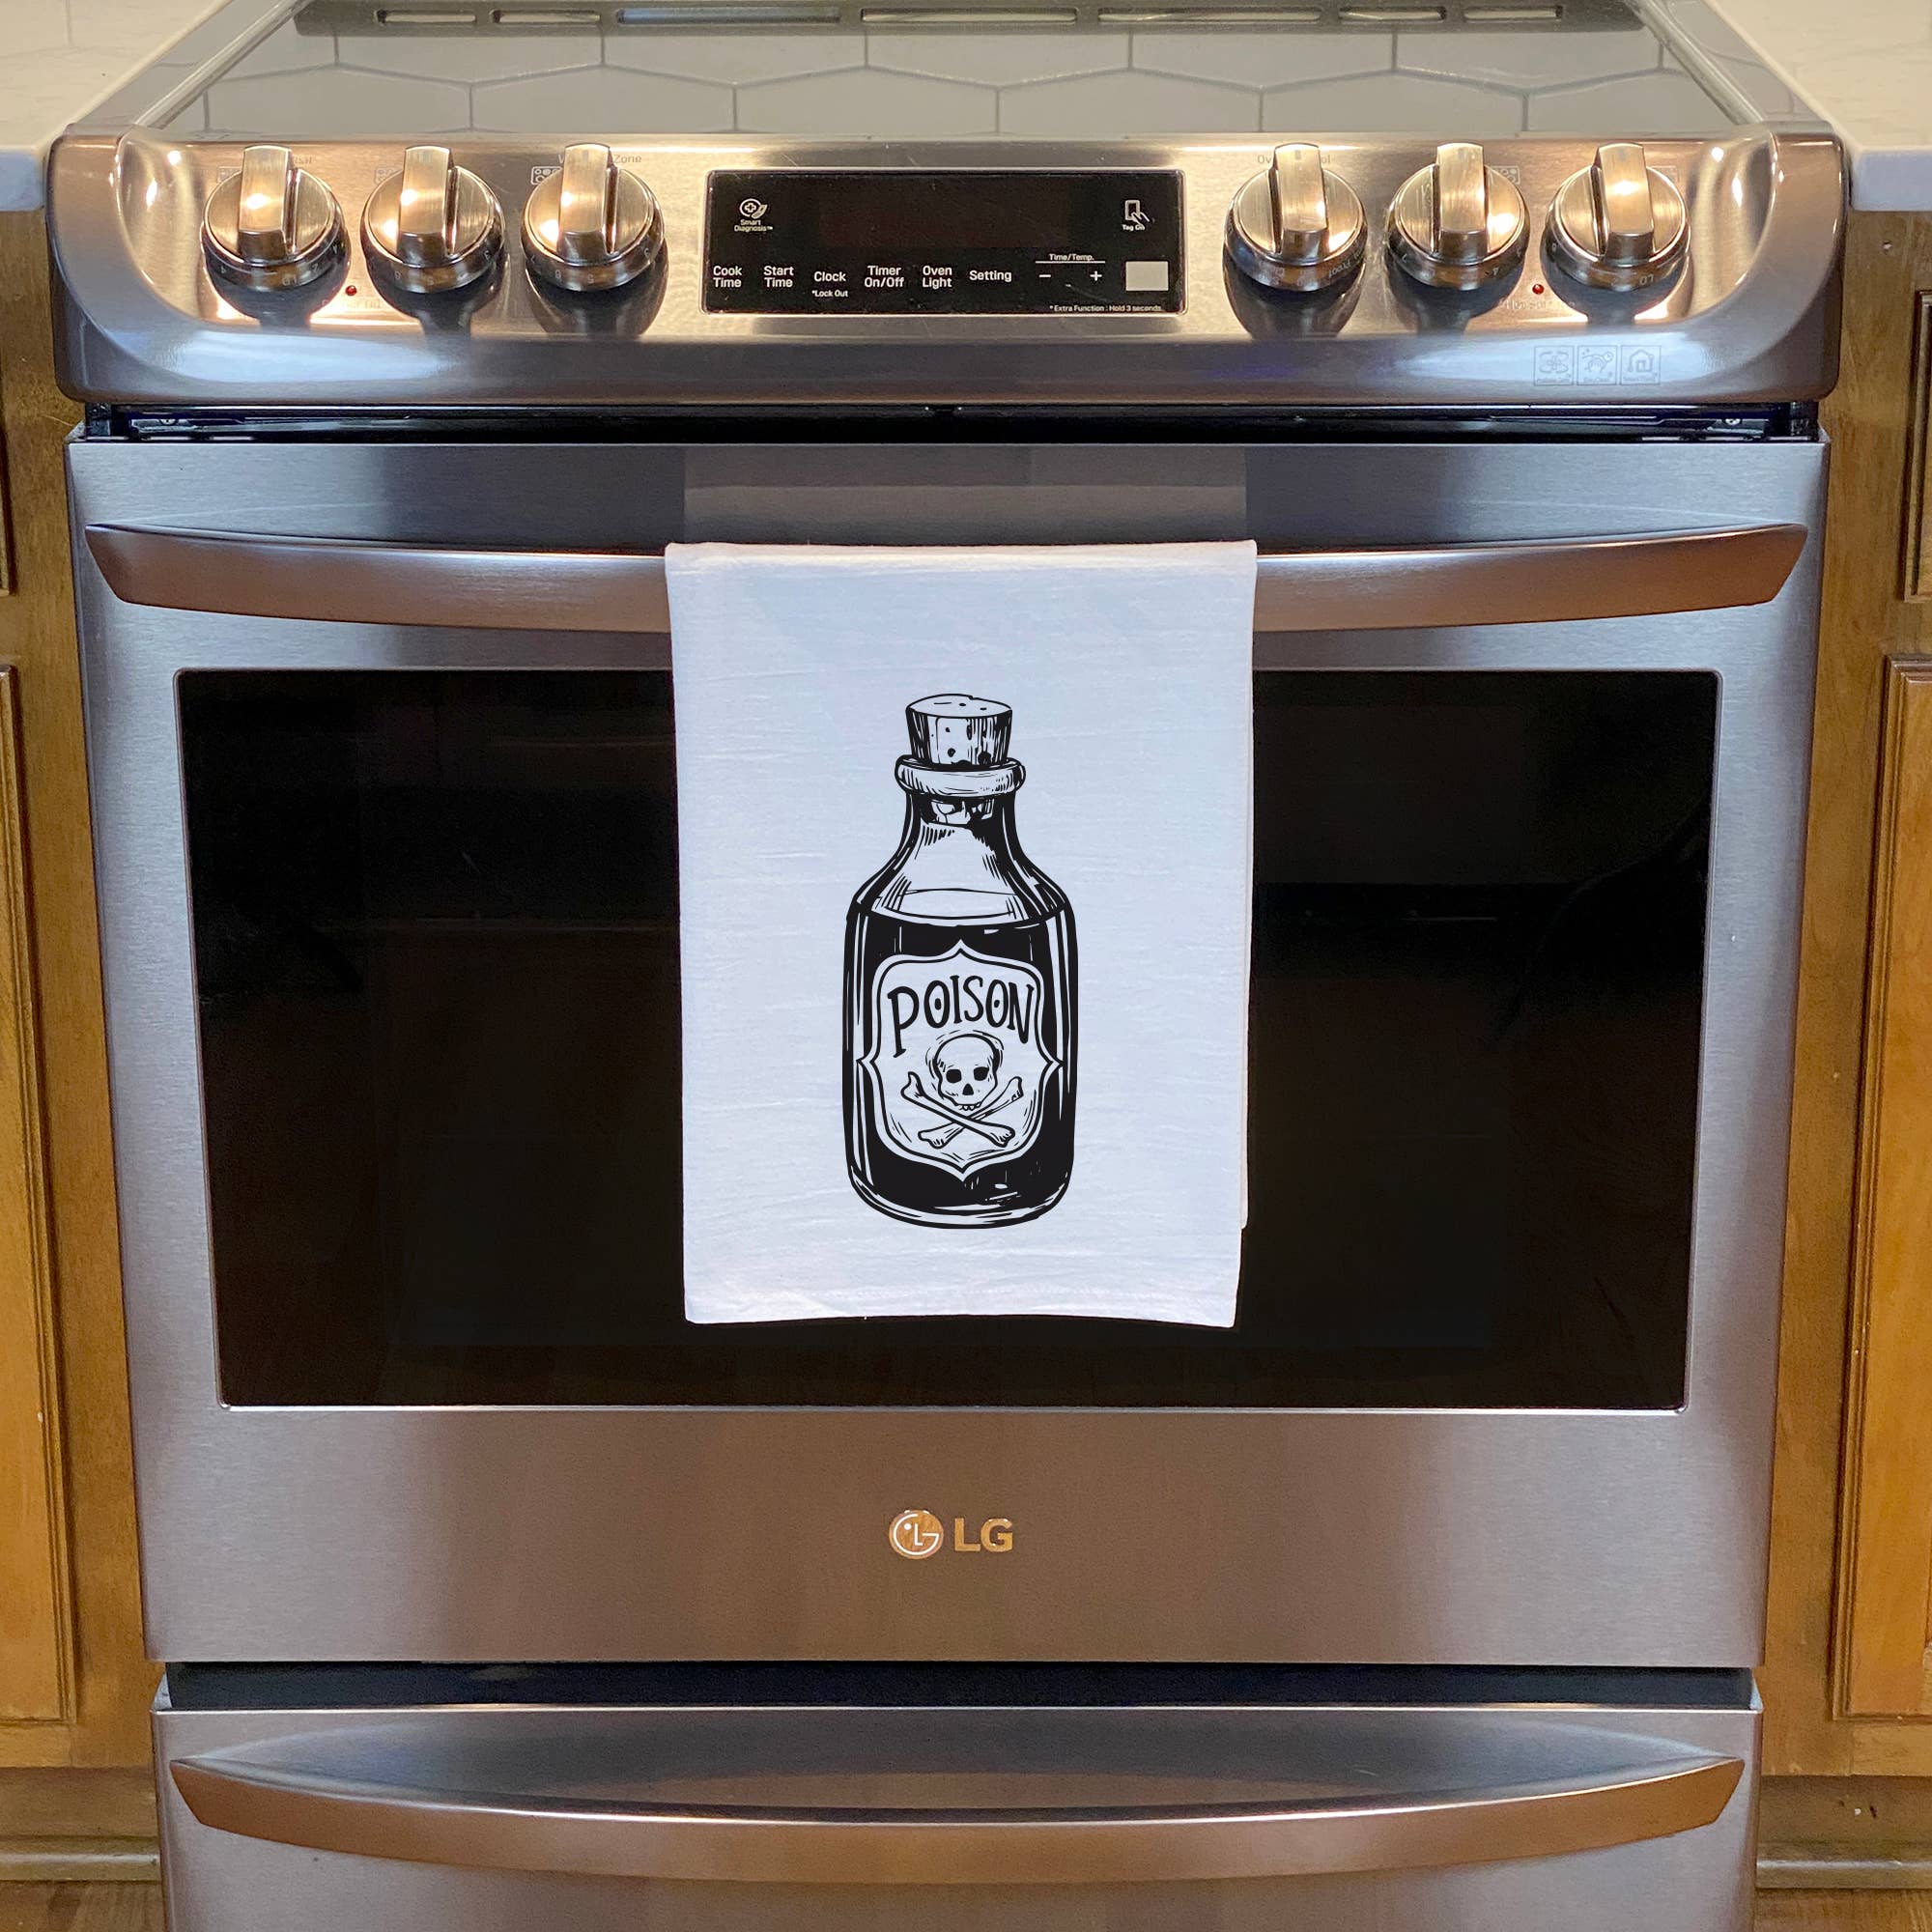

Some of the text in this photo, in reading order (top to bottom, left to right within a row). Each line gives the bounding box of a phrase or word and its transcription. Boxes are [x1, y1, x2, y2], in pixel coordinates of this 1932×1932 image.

[1048, 253, 1094, 262] Time/Temp.
[713, 266, 743, 276] Cook
[763, 266, 794, 276] Start
[813, 270, 846, 282] Clock
[867, 265, 902, 276] Timer
[923, 265, 952, 276] Oven
[969, 270, 1012, 283] Setting
[713, 276, 742, 288] Time
[764, 276, 793, 288] Time
[864, 276, 905, 288] On/Off
[922, 277, 952, 290] Light
[887, 975, 1036, 1058] POISON
[954, 1518, 1013, 1552] LG
